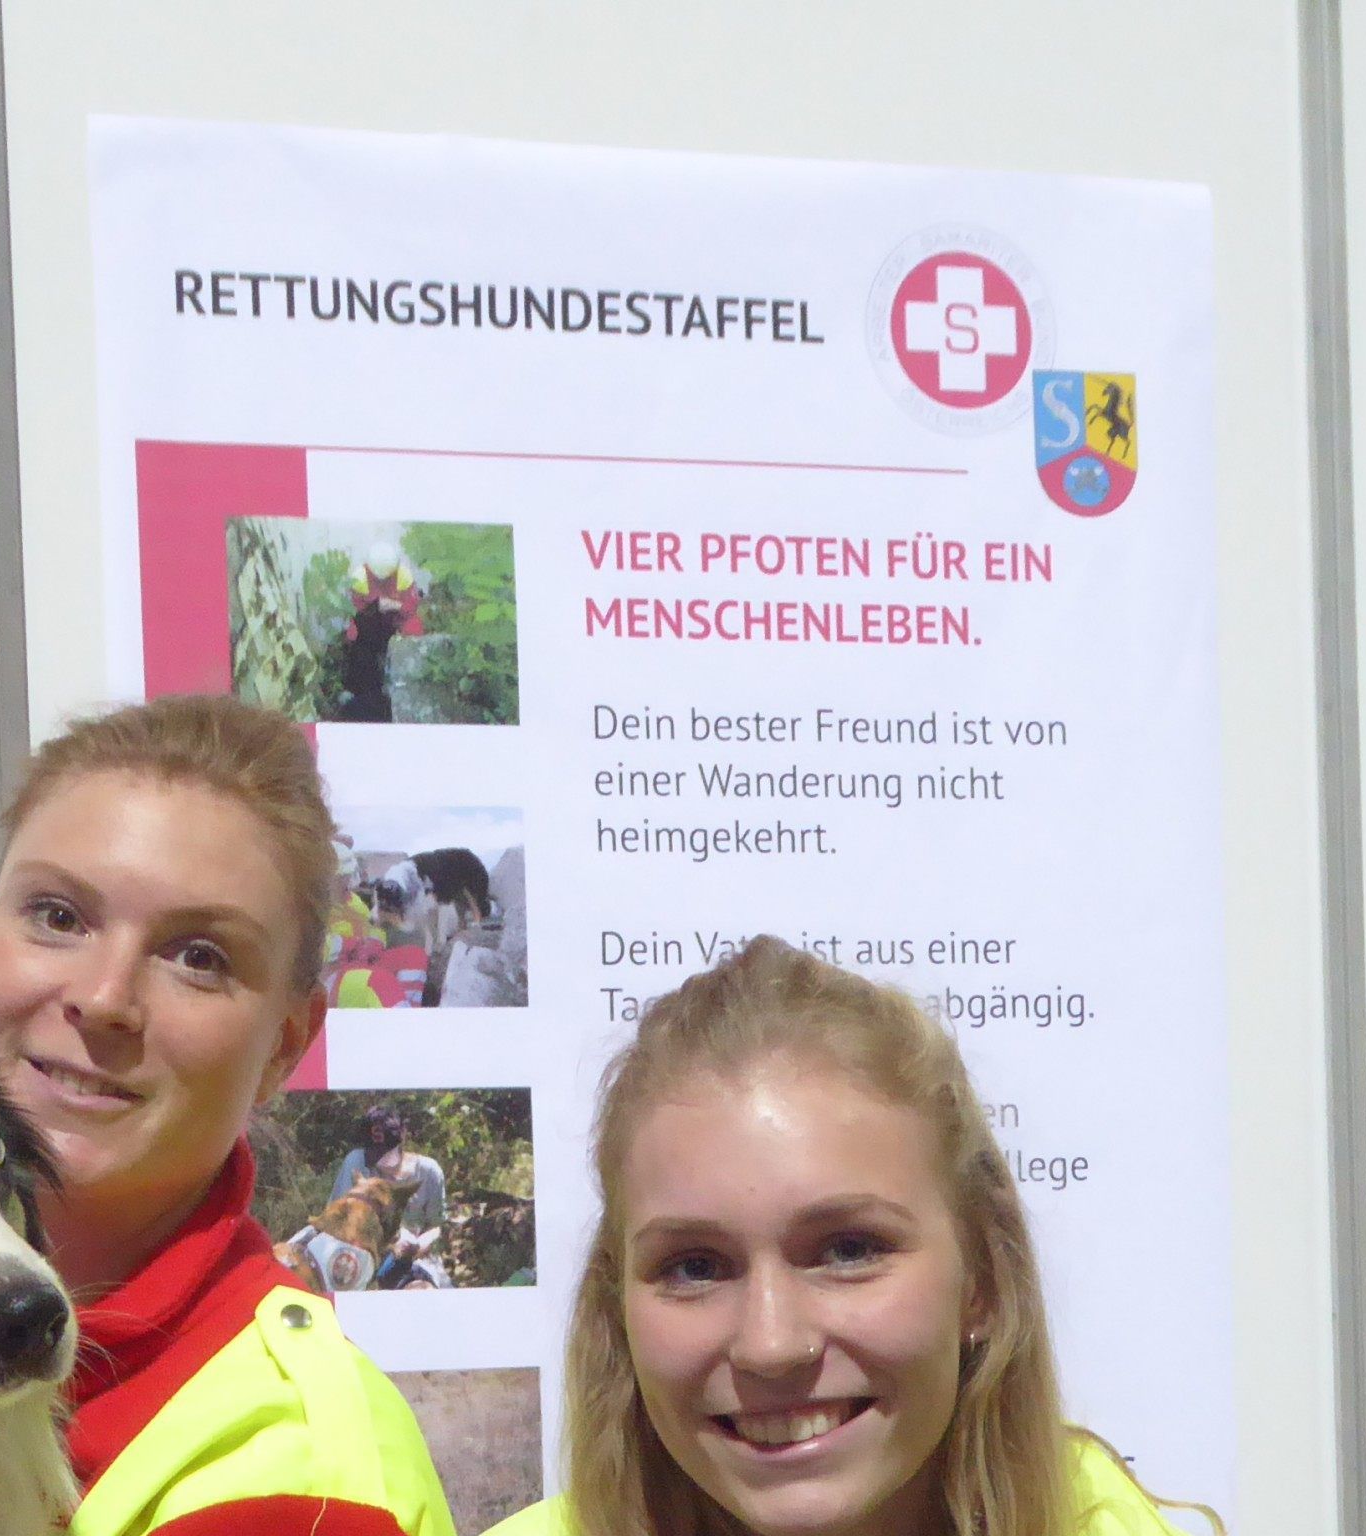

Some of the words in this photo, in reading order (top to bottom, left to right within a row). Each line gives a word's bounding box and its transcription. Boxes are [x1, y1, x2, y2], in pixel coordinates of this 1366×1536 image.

[175, 270, 826, 346] RETTUNGSHUNDESTAFFEL
[943, 302, 979, 354] S
[581, 530, 684, 572] VIER
[701, 533, 871, 577] PFOTEN
[887, 531, 969, 580] FÜR
[984, 542, 1053, 582] EIN
[584, 597, 982, 646] MENSCHENLEBEN.
[593, 705, 676, 743] Dein
[691, 706, 800, 744] bester
[816, 709, 937, 746] Freund
[952, 710, 994, 746] ist
[1004, 717, 1068, 747] von
[594, 762, 687, 798] einer
[698, 764, 903, 808] Wanderung
[917, 766, 1005, 801] nicht
[596, 819, 838, 863] heimgekehrt.
[600, 930, 684, 966] Dein
[856, 937, 915, 965] aus
[927, 934, 1017, 965] einer
[926, 985, 1096, 1029] abgängig.
